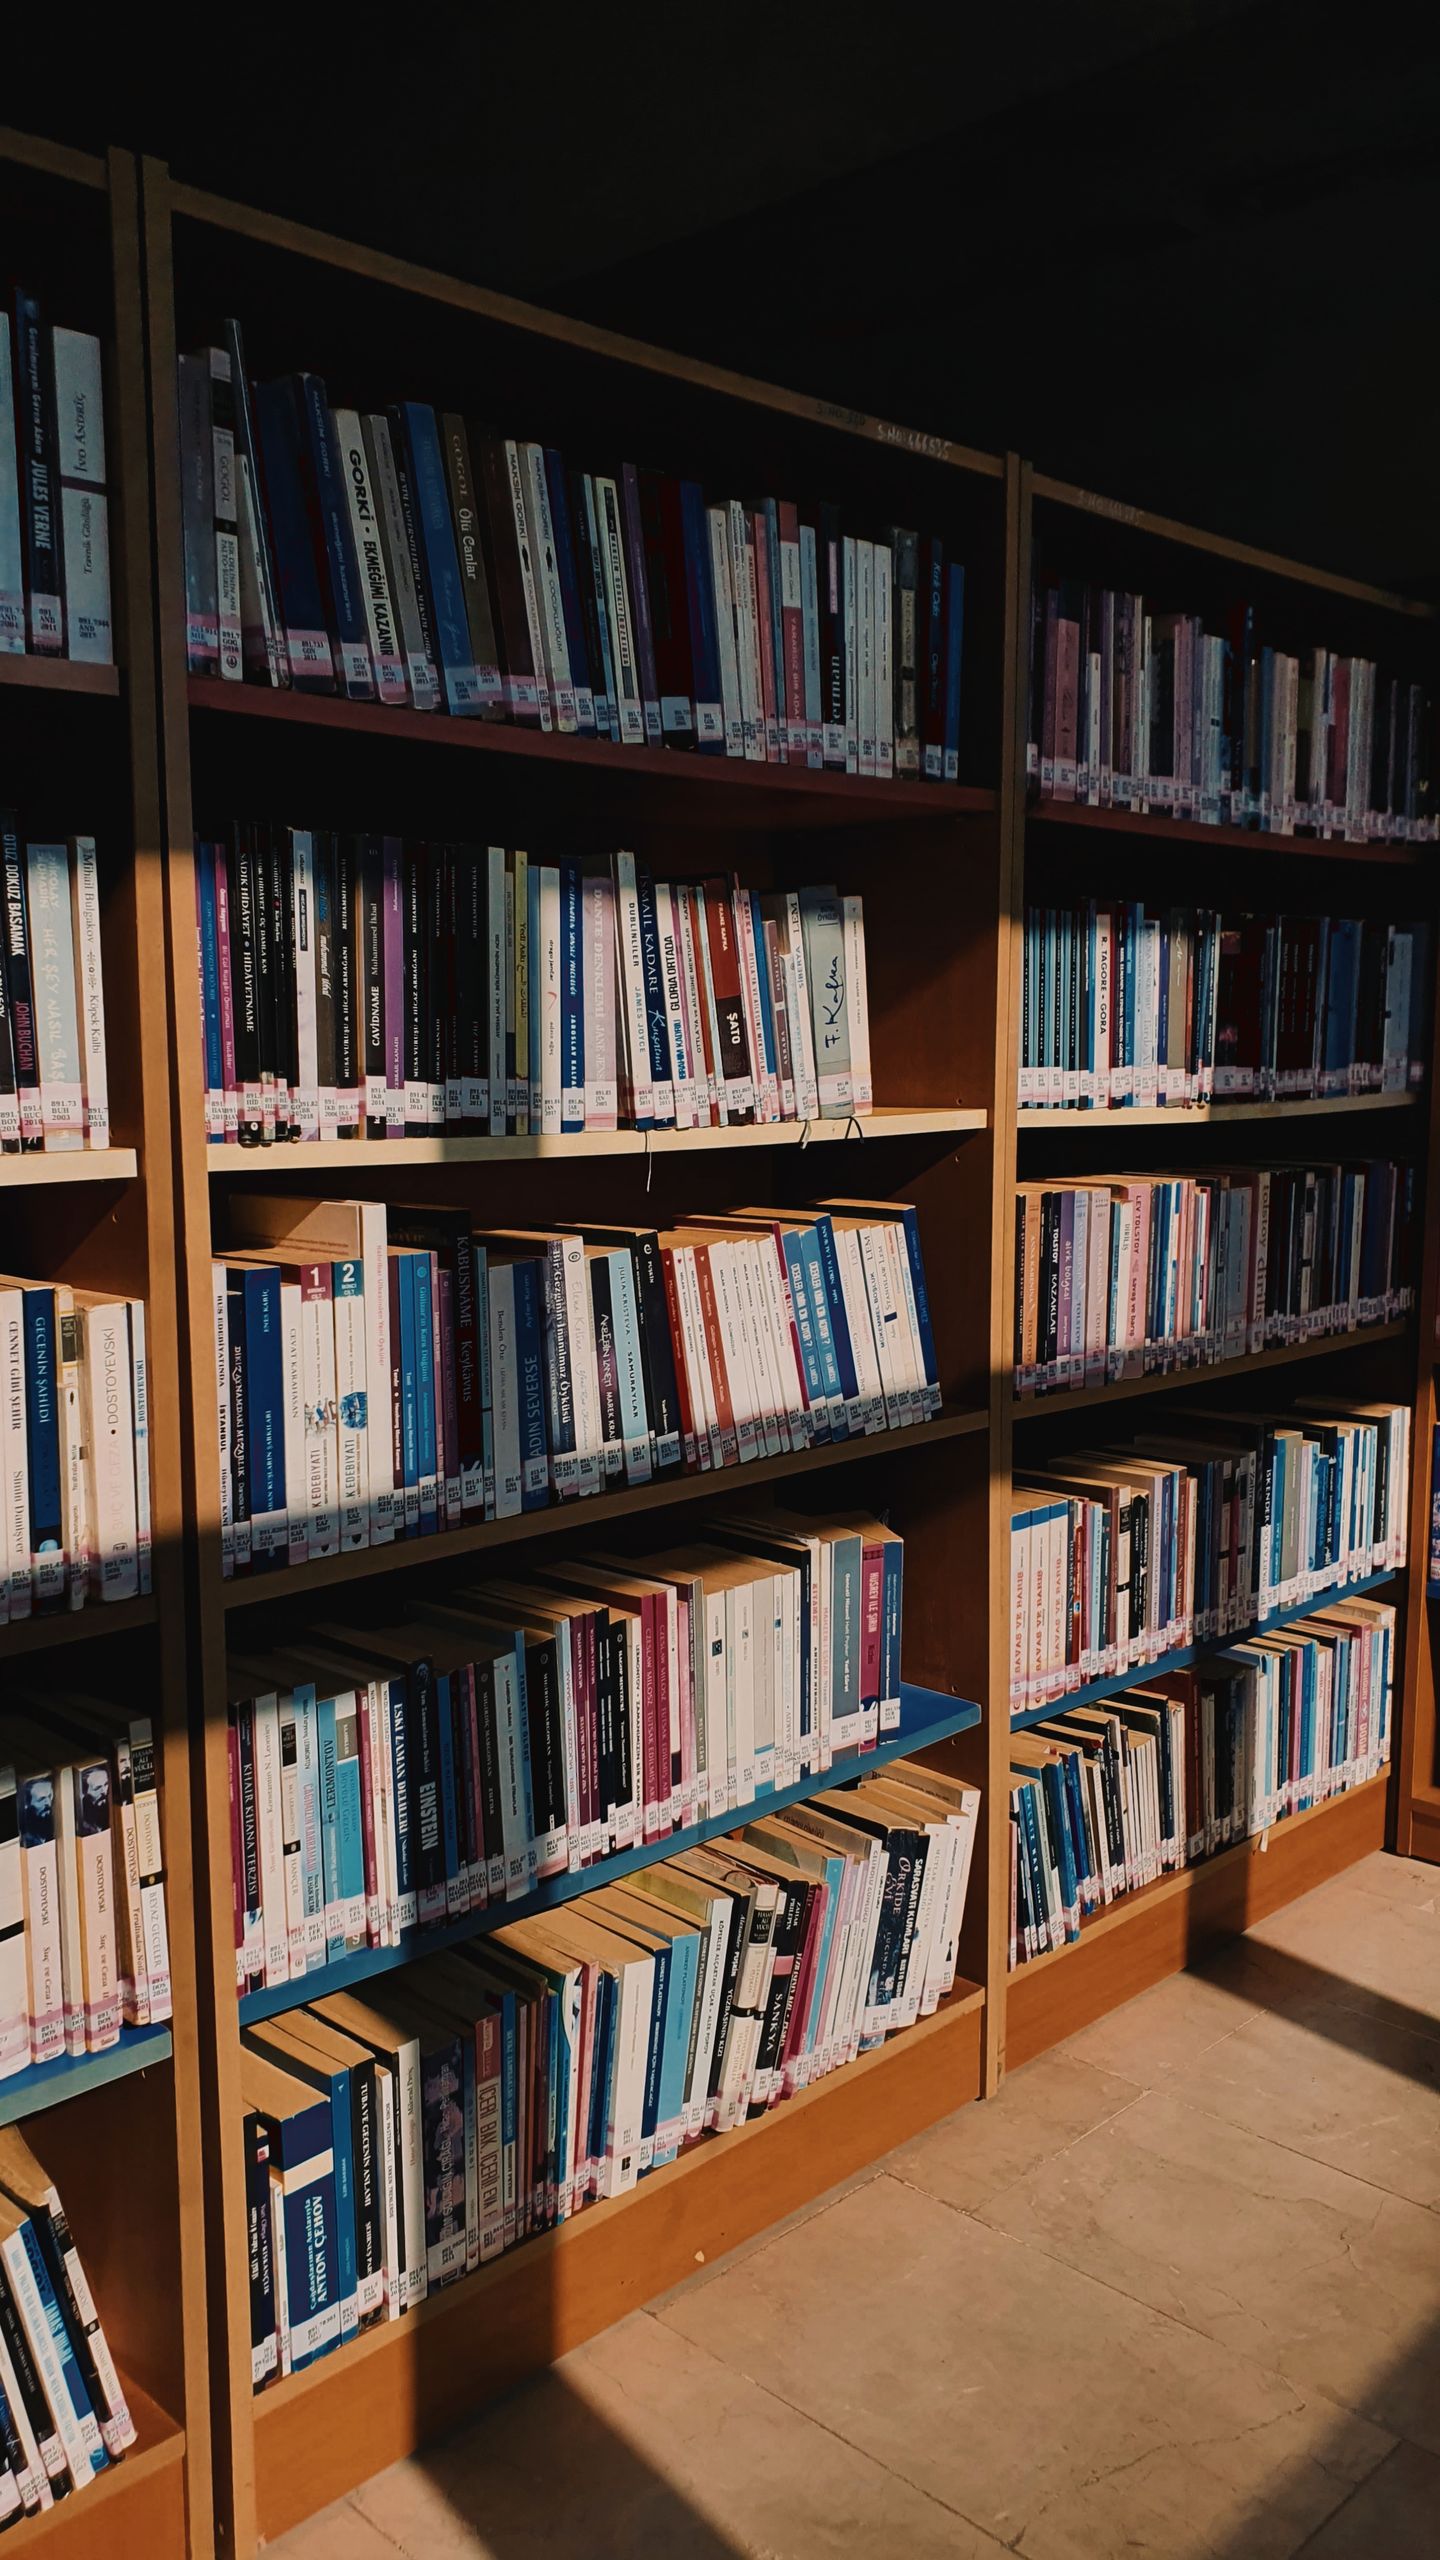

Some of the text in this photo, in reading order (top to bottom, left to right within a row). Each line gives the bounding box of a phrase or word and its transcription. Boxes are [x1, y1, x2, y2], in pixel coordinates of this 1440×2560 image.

[32, 460, 52, 551] JULES VERNE
[218, 456, 231, 504] GOGOL
[347, 448, 373, 522] GORKİ
[509, 452, 528, 539] MAKSİM GORKİ
[534, 455, 546, 501] MAKSİM
[541, 502, 551, 541] GORKİ
[363, 540, 386, 601] EKMEĞİMİ
[458, 507, 479, 580] Ölü Canlar
[373, 602, 397, 658] KAZANIR
[3, 834, 26, 957] OTUZ DOKUZ BASAMAK
[790, 901, 800, 933] LEM
[40, 928, 62, 1044] HER ŞEY NASIL
[82, 854, 103, 1054] Mihail Bulgakov Köpek Kalbi
[369, 926, 382, 1047] CAVİDNAME Muhammed
[593, 888, 606, 1055] DANTE DENKLEMİ JANE
[628, 901, 640, 967] DUBLİNLİLER
[634, 985, 644, 1020] JAMES
[644, 932, 659, 994] KADARE
[663, 935, 681, 1011] GLORIA ORTADA
[15, 1000, 32, 1071] JOHN BUCHAN
[726, 1011, 742, 1045] ŞATO
[822, 955, 845, 1048] F. Kafka
[342, 1263, 355, 1283] 2
[456, 1236, 474, 1328] KABUSNÂME
[863, 1235, 875, 1261] LEM
[496, 1310, 506, 1342] Benden
[621, 1293, 632, 1335] KRISTEVA
[1049, 1273, 1059, 1336] KAZAKLAR
[7, 1320, 20, 1365] CENNET
[34, 1316, 53, 1424] GECENİN ŞAHİDİ
[100, 1326, 120, 1425] DOSTOYEVSKİ
[460, 1340, 475, 1402] Keykâvus
[552, 1270, 565, 1321] Gezginin
[559, 1380, 573, 1424] Öyküsü
[9, 1368, 22, 1393] GİBİ
[9, 1394, 23, 1431] ŞEHİR
[523, 1354, 541, 1418] SEVERSE
[606, 1391, 616, 1418] MAREK
[626, 1350, 639, 1418] SAMURAYLAR
[646, 1710, 656, 1746] TUTSAK
[322, 1739, 337, 1809] LERMONTOV
[392, 1702, 410, 1834] ESKİ ZAMAN DELİLERİ
[243, 1762, 260, 1896] KHAIR KHANA TERZİSİ
[419, 1780, 439, 1851] EINSTEIN
[95, 1854, 108, 1913] DOSTOYEVSKİ
[125, 1826, 139, 1887] DOSTOYEVSKİ
[892, 1855, 913, 1916] ORKİDE
[38, 1865, 50, 1925] DOSTOYEVSKİ
[148, 1890, 164, 1968] BEYAZ GECELER
[791, 1900, 802, 1928] ZAHAR
[900, 1857, 924, 1955] SARASVATİ KUMLARI
[730, 1950, 742, 1978] PUŞKİN
[716, 1987, 735, 2057] YÜZBAŞININ KIZI
[765, 1992, 784, 2053] SANKYA
[359, 2082, 370, 2105] TUBA
[361, 2124, 372, 2164] GECENİN
[478, 2082, 499, 2207] İÇERİ EVA
[362, 2164, 373, 2208] ANLAMI
[303, 2198, 319, 2311] Çağdaşlarının Anılarıyla
[311, 2194, 328, 2303] ANTON ÇEHOV
